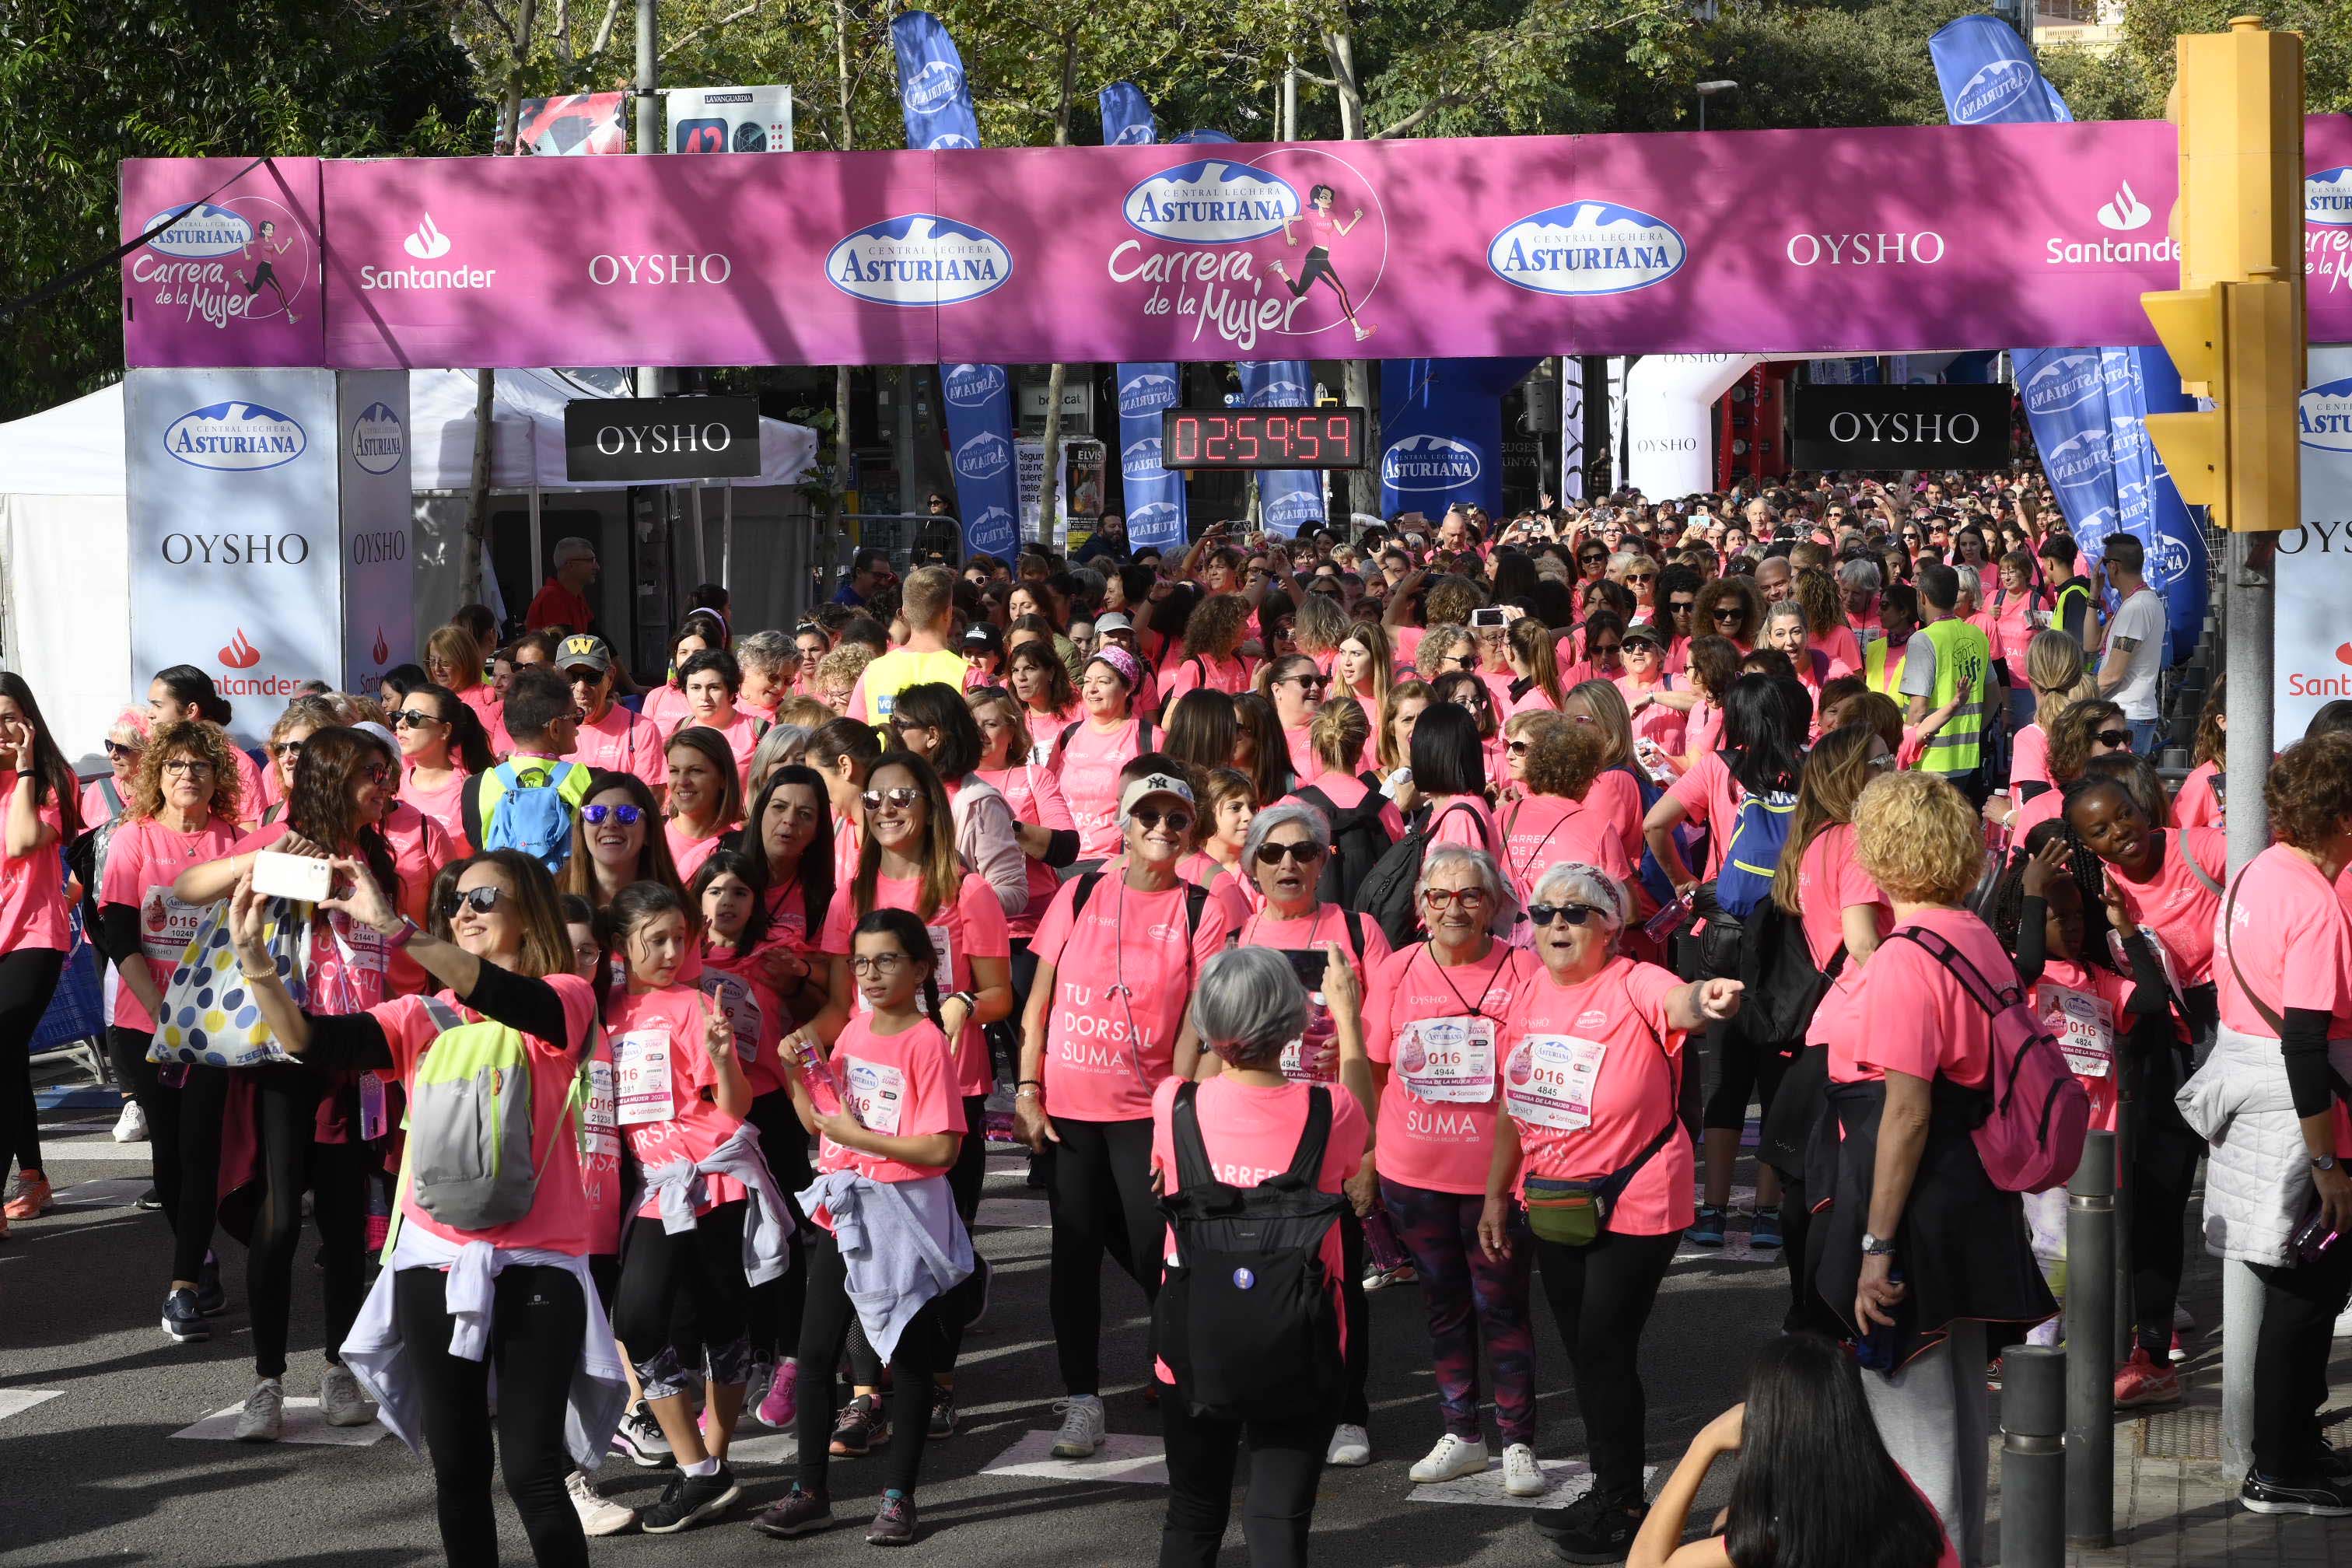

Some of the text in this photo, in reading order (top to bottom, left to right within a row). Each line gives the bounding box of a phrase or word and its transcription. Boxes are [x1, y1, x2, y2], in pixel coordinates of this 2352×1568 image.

[1164, 186, 1282, 198] CENTRAL LECHERA
[1138, 191, 1286, 223] ASTURIANA
[1533, 232, 1664, 243] CENTRAL LECHERA
[868, 247, 927, 256] CENTRAL
[1503, 236, 1671, 272] ASTURIANA
[1787, 231, 1945, 266] OYSHO
[2046, 236, 2181, 264] Santande
[133, 254, 225, 283] Carrera
[588, 253, 732, 285] OYSHO
[839, 249, 999, 283] ASTURIANA
[1107, 240, 1252, 283] Carrera
[361, 264, 496, 290] Santander
[156, 281, 260, 329] de la Mujer
[1143, 277, 1309, 351] de la Mujer
[197, 425, 292, 433] CENTRAL LECHERA
[1829, 412, 1980, 444] OYSHO
[175, 428, 296, 454] ASTURIANA
[355, 432, 401, 457] ASTURIANA
[596, 422, 732, 456] OYSHO
[1176, 417, 1350, 460] 02:59:59
[1637, 437, 1696, 453] OYSHO
[1077, 450, 1101, 460] ELVIS
[1502, 457, 1538, 467] UNYA
[1385, 456, 1473, 480] ASTURIANA
[1020, 474, 1045, 483] quiere
[161, 533, 310, 565] OYSHO
[353, 530, 405, 566] OYSHO
[566, 638, 594, 655] W
[214, 674, 302, 696] ntander
[878, 699, 892, 710] VO
[1511, 845, 1544, 857] DE LA
[169, 915, 198, 928] 016
[354, 933, 375, 942] 21441
[1064, 982, 1091, 1006] TU
[1410, 995, 1448, 1006] OYSHO
[1064, 1011, 1155, 1049] DORSAL
[1429, 1031, 1464, 1041] ASTURIANA
[2070, 1020, 2097, 1037] 016
[2074, 1037, 2093, 1047] 4824
[1061, 1040, 1127, 1068] SUMA
[1428, 1052, 1461, 1066] 016
[1537, 1047, 1570, 1061] ASTURIANA
[614, 1068, 639, 1083] 016
[1434, 1068, 1455, 1076] 4944
[1534, 1068, 1565, 1086] 016
[1457, 1089, 1487, 1097] Santander
[1537, 1085, 1558, 1097] 4845
[590, 1097, 614, 1112] 016
[848, 1095, 871, 1112] 016
[1512, 1092, 1535, 1103] CARRERA
[1544, 1097, 1552, 1106] LA
[1552, 1100, 1570, 1110] MUJER
[591, 1114, 611, 1125] 21238
[1407, 1111, 1478, 1135] SUMA
